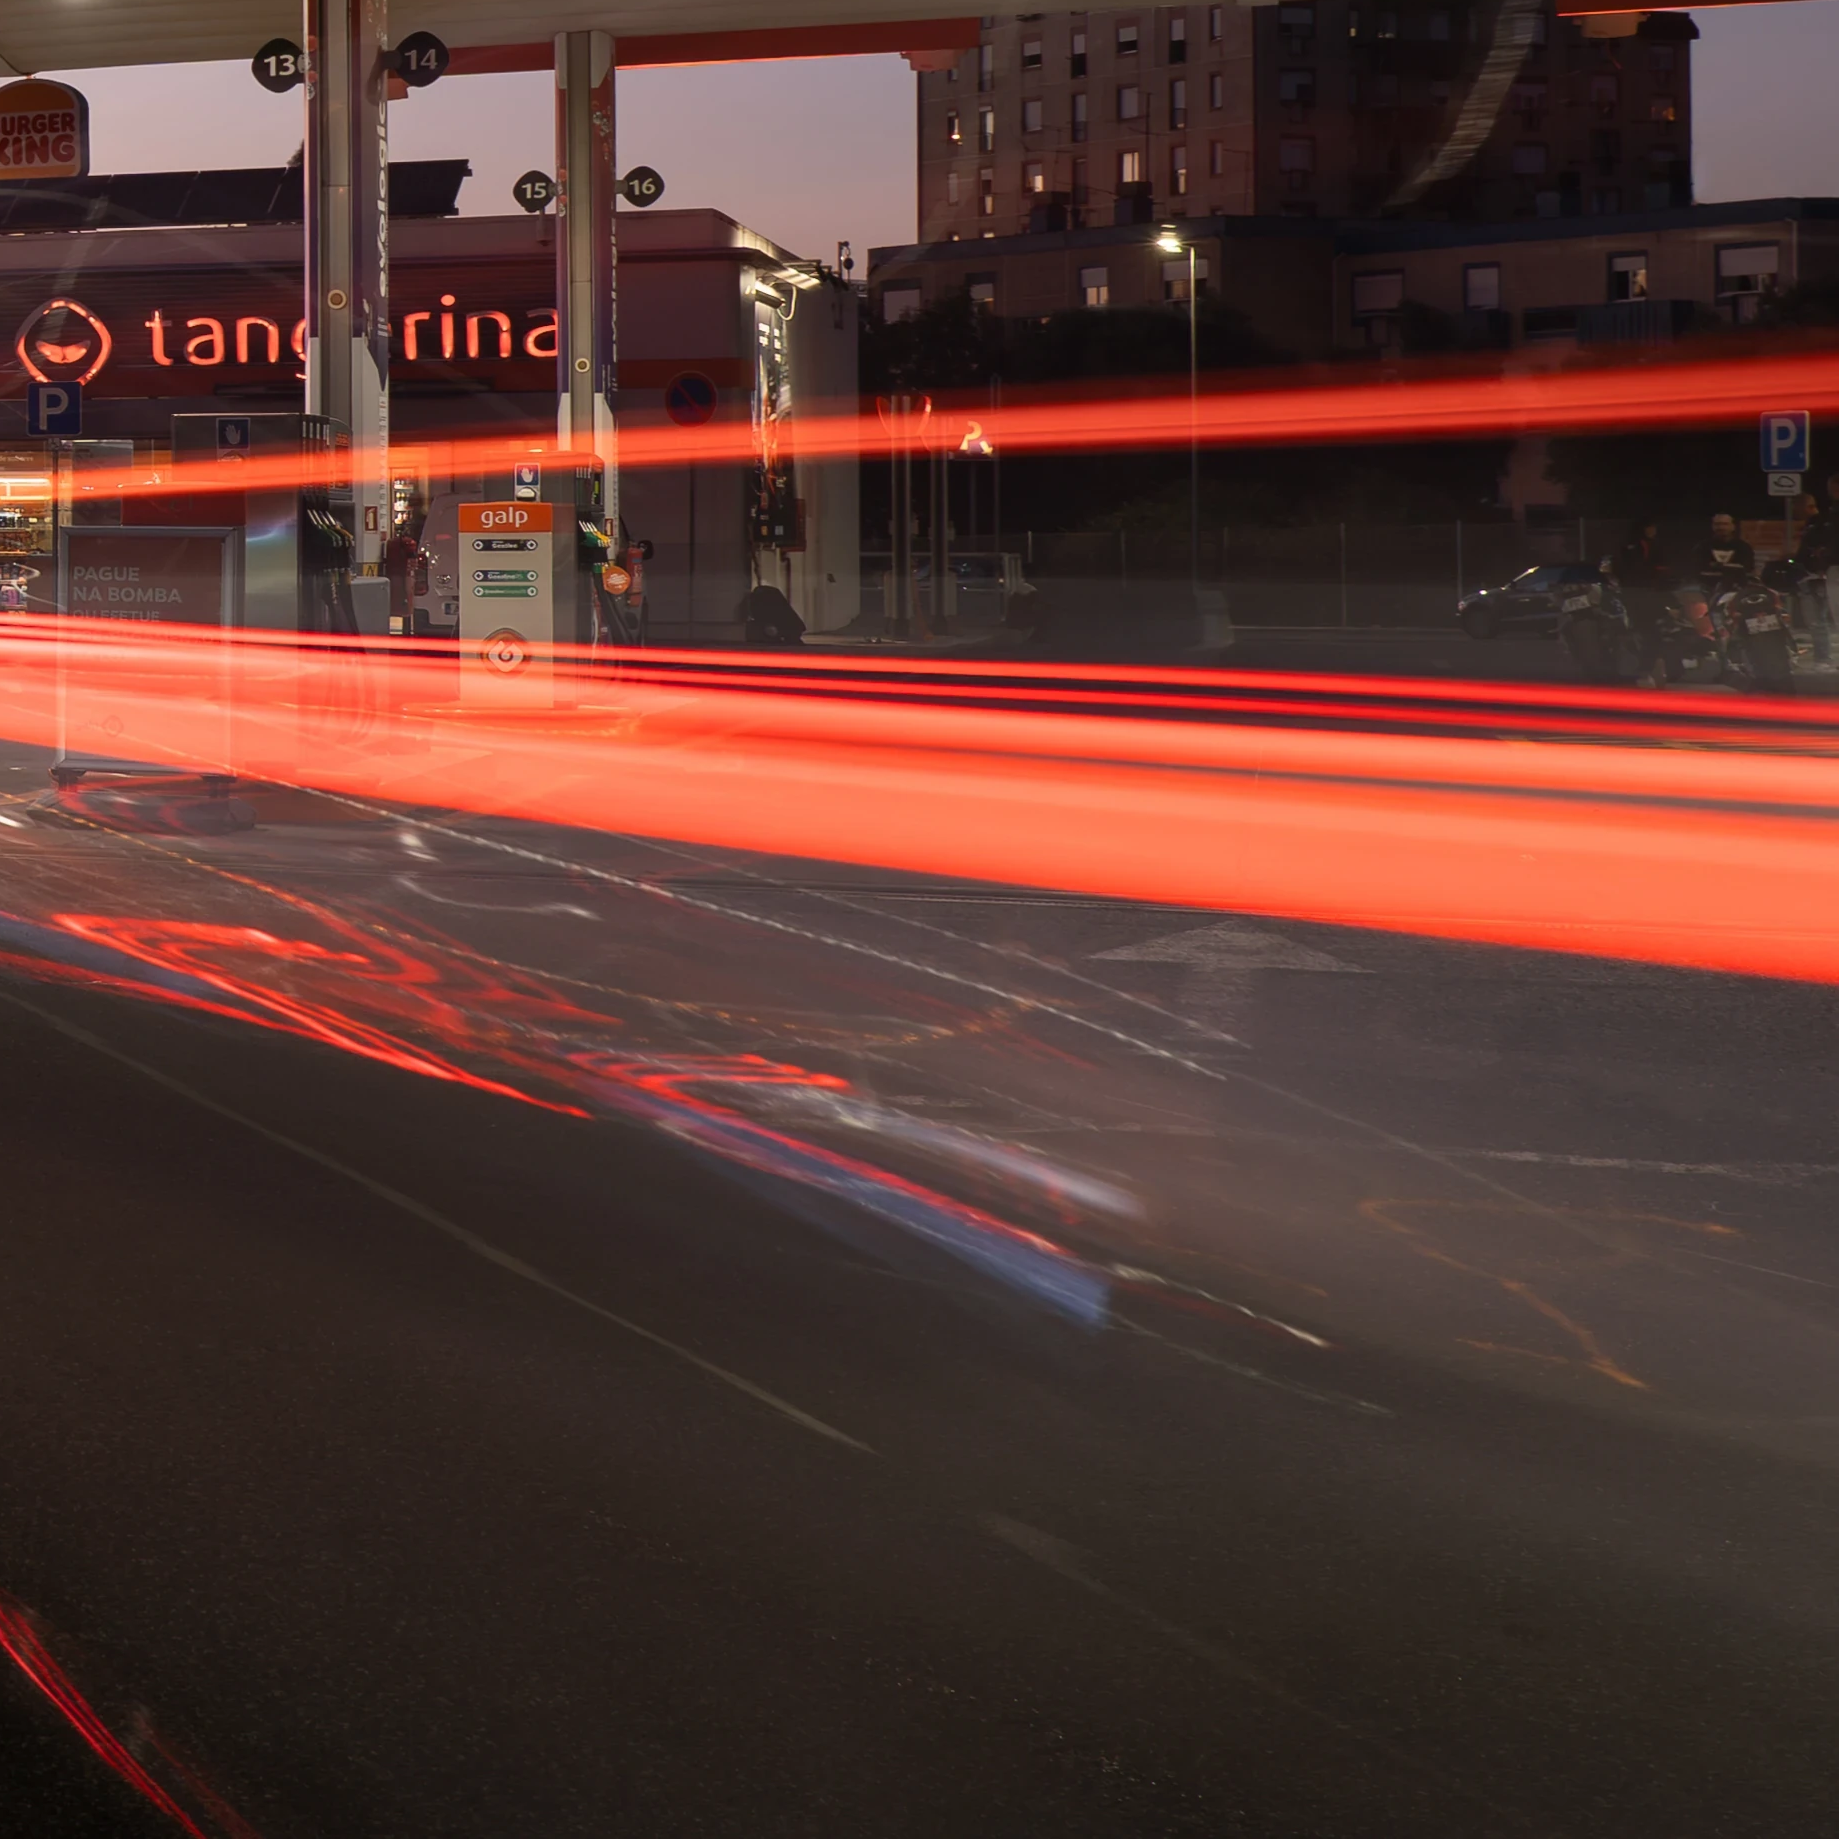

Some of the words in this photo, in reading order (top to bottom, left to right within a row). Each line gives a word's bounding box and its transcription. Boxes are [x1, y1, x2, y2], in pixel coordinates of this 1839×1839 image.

[263, 53, 297, 77] 13
[403, 47, 440, 72] 14
[523, 182, 547, 200] 15
[628, 176, 658, 197] 16
[38, 389, 69, 423] P
[1769, 417, 1796, 466] P
[481, 506, 529, 529] galp
[73, 566, 140, 582] PAGUE
[73, 586, 101, 602] NA
[108, 588, 183, 604] BOMBA
